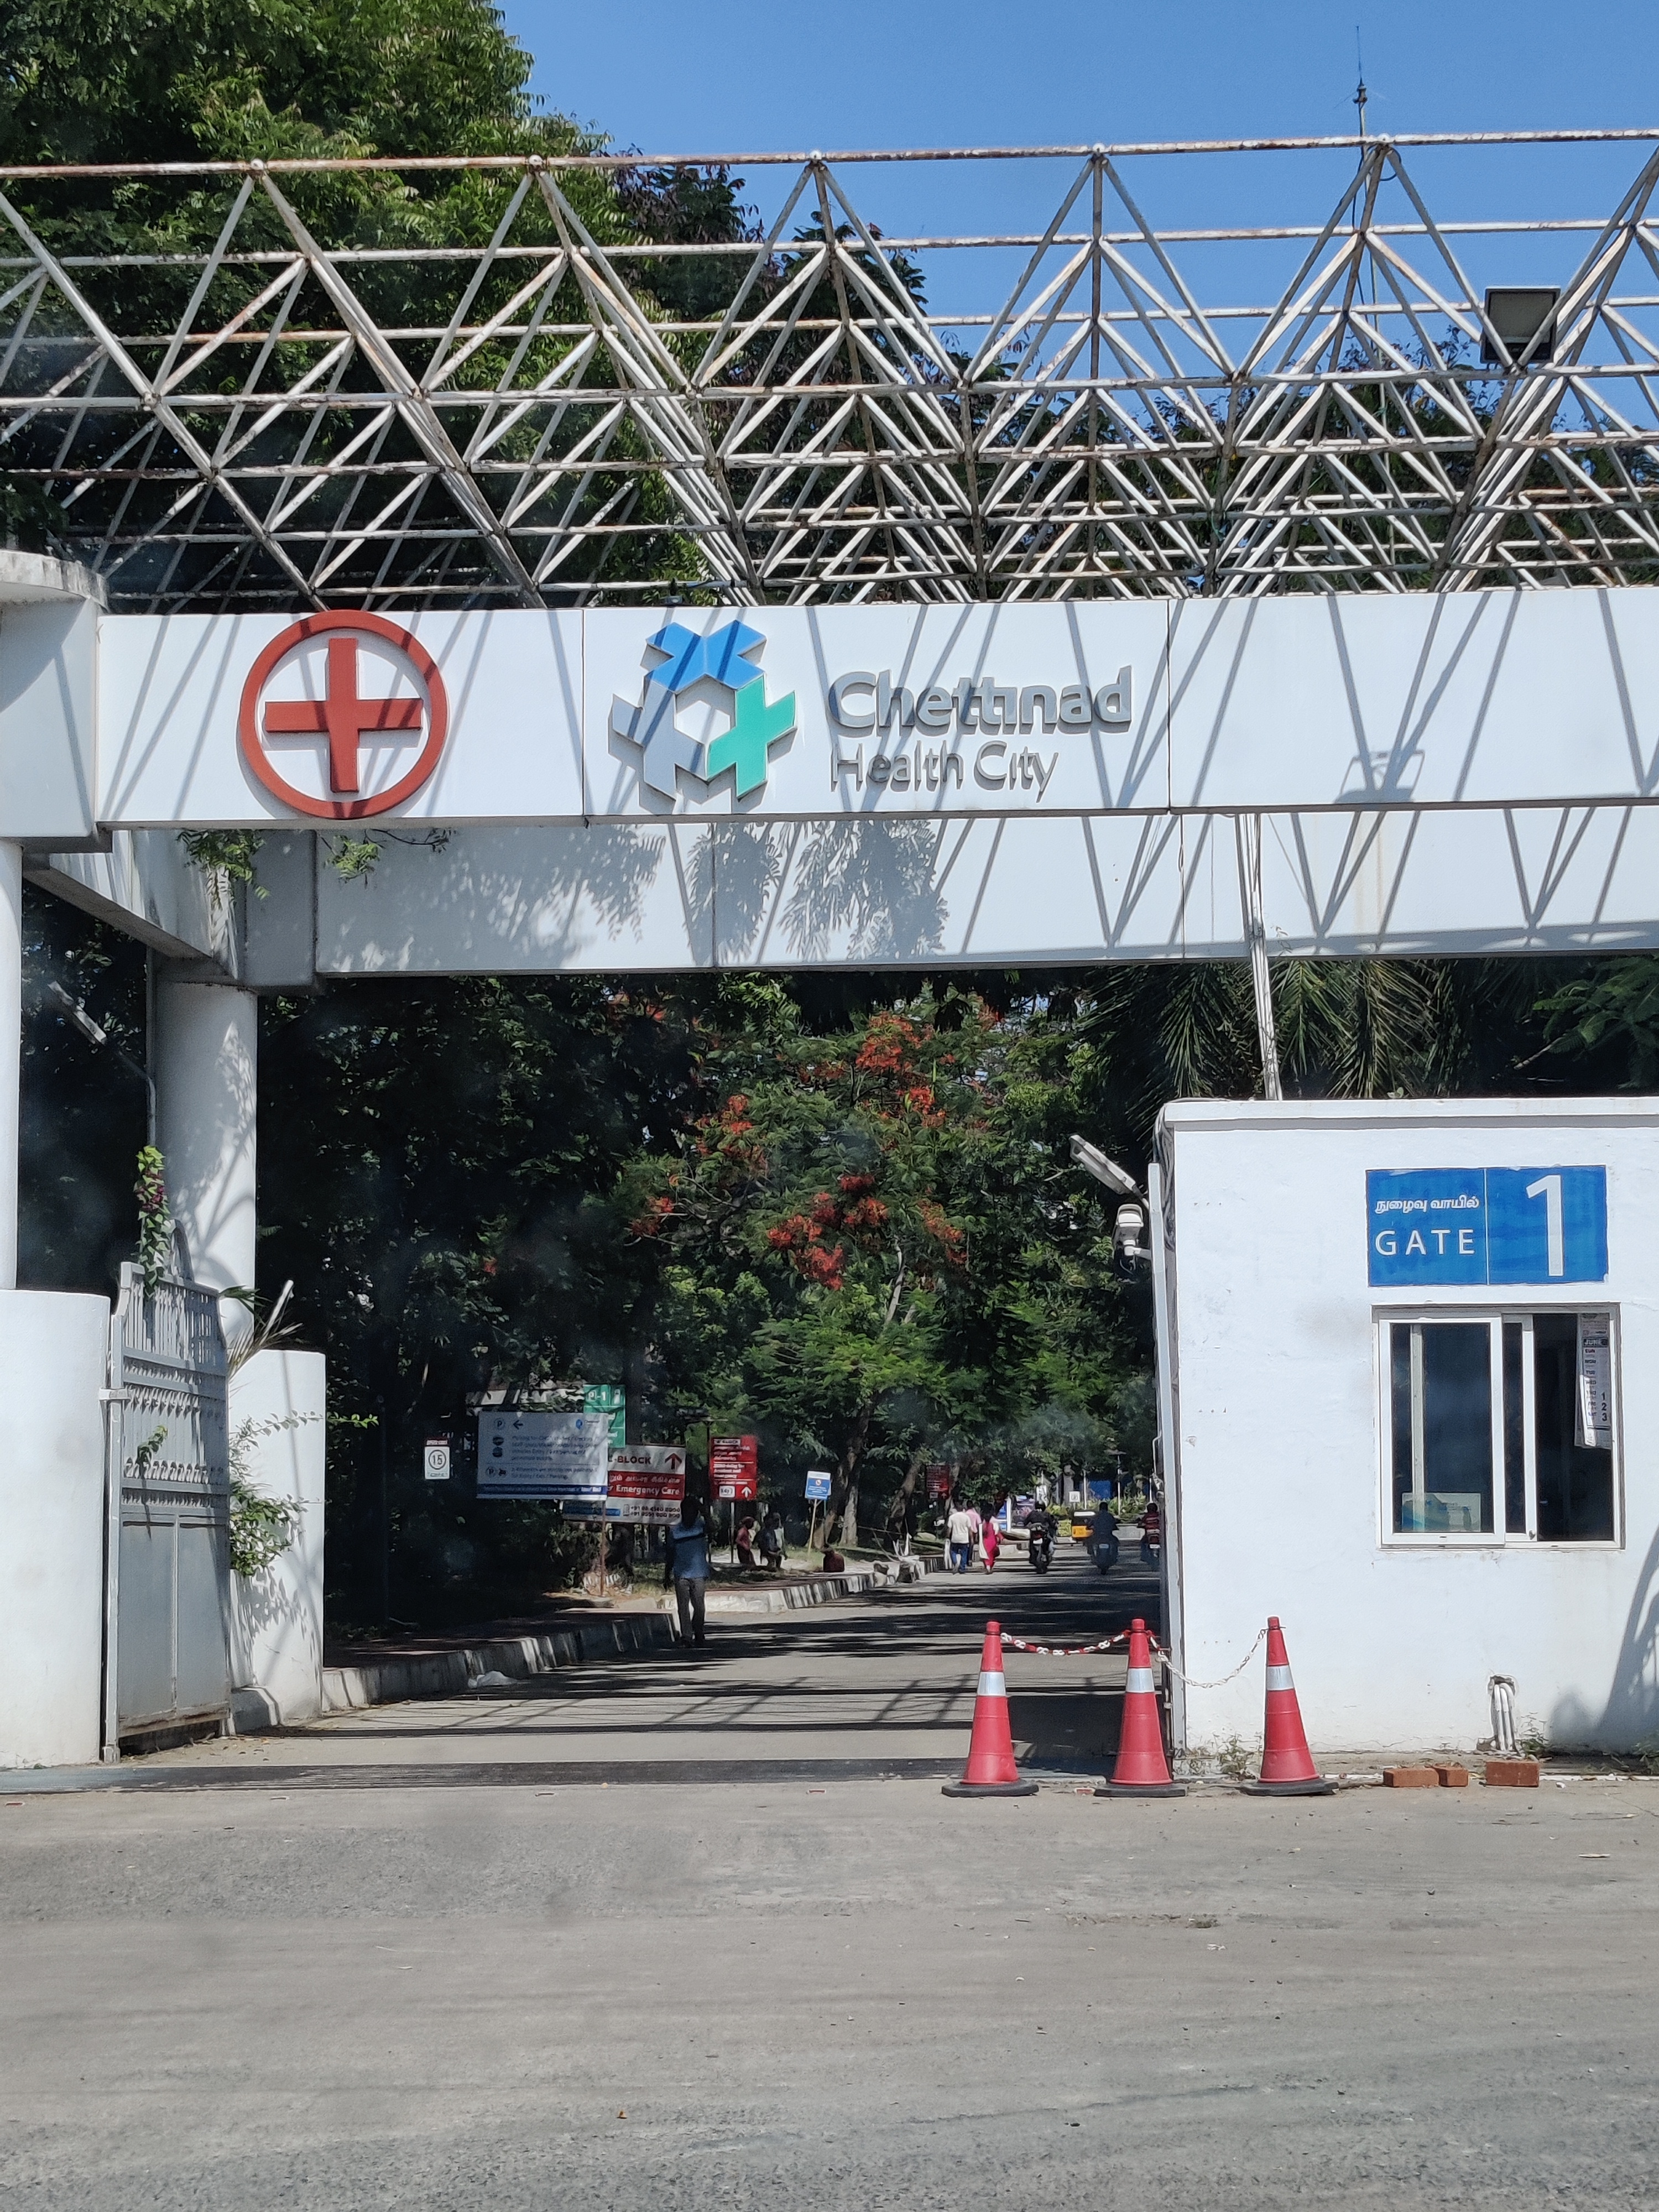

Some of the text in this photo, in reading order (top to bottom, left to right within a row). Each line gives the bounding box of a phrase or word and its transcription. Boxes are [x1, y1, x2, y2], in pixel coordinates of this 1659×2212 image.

[829, 665, 1132, 734] Chettinad
[831, 740, 1059, 803] Health City
[1375, 1194, 1480, 1214] நுழைவு வாயில்
[1526, 1174, 1564, 1277] 1
[1375, 1229, 1475, 1256] GATE
[1601, 1391, 1606, 1401] 1
[1601, 1402, 1607, 1411] 2
[1601, 1412, 1608, 1422] 3
[432, 1454, 443, 1465] 15
[615, 1484, 660, 1495] Emergency
[661, 1486, 680, 1495] Care
